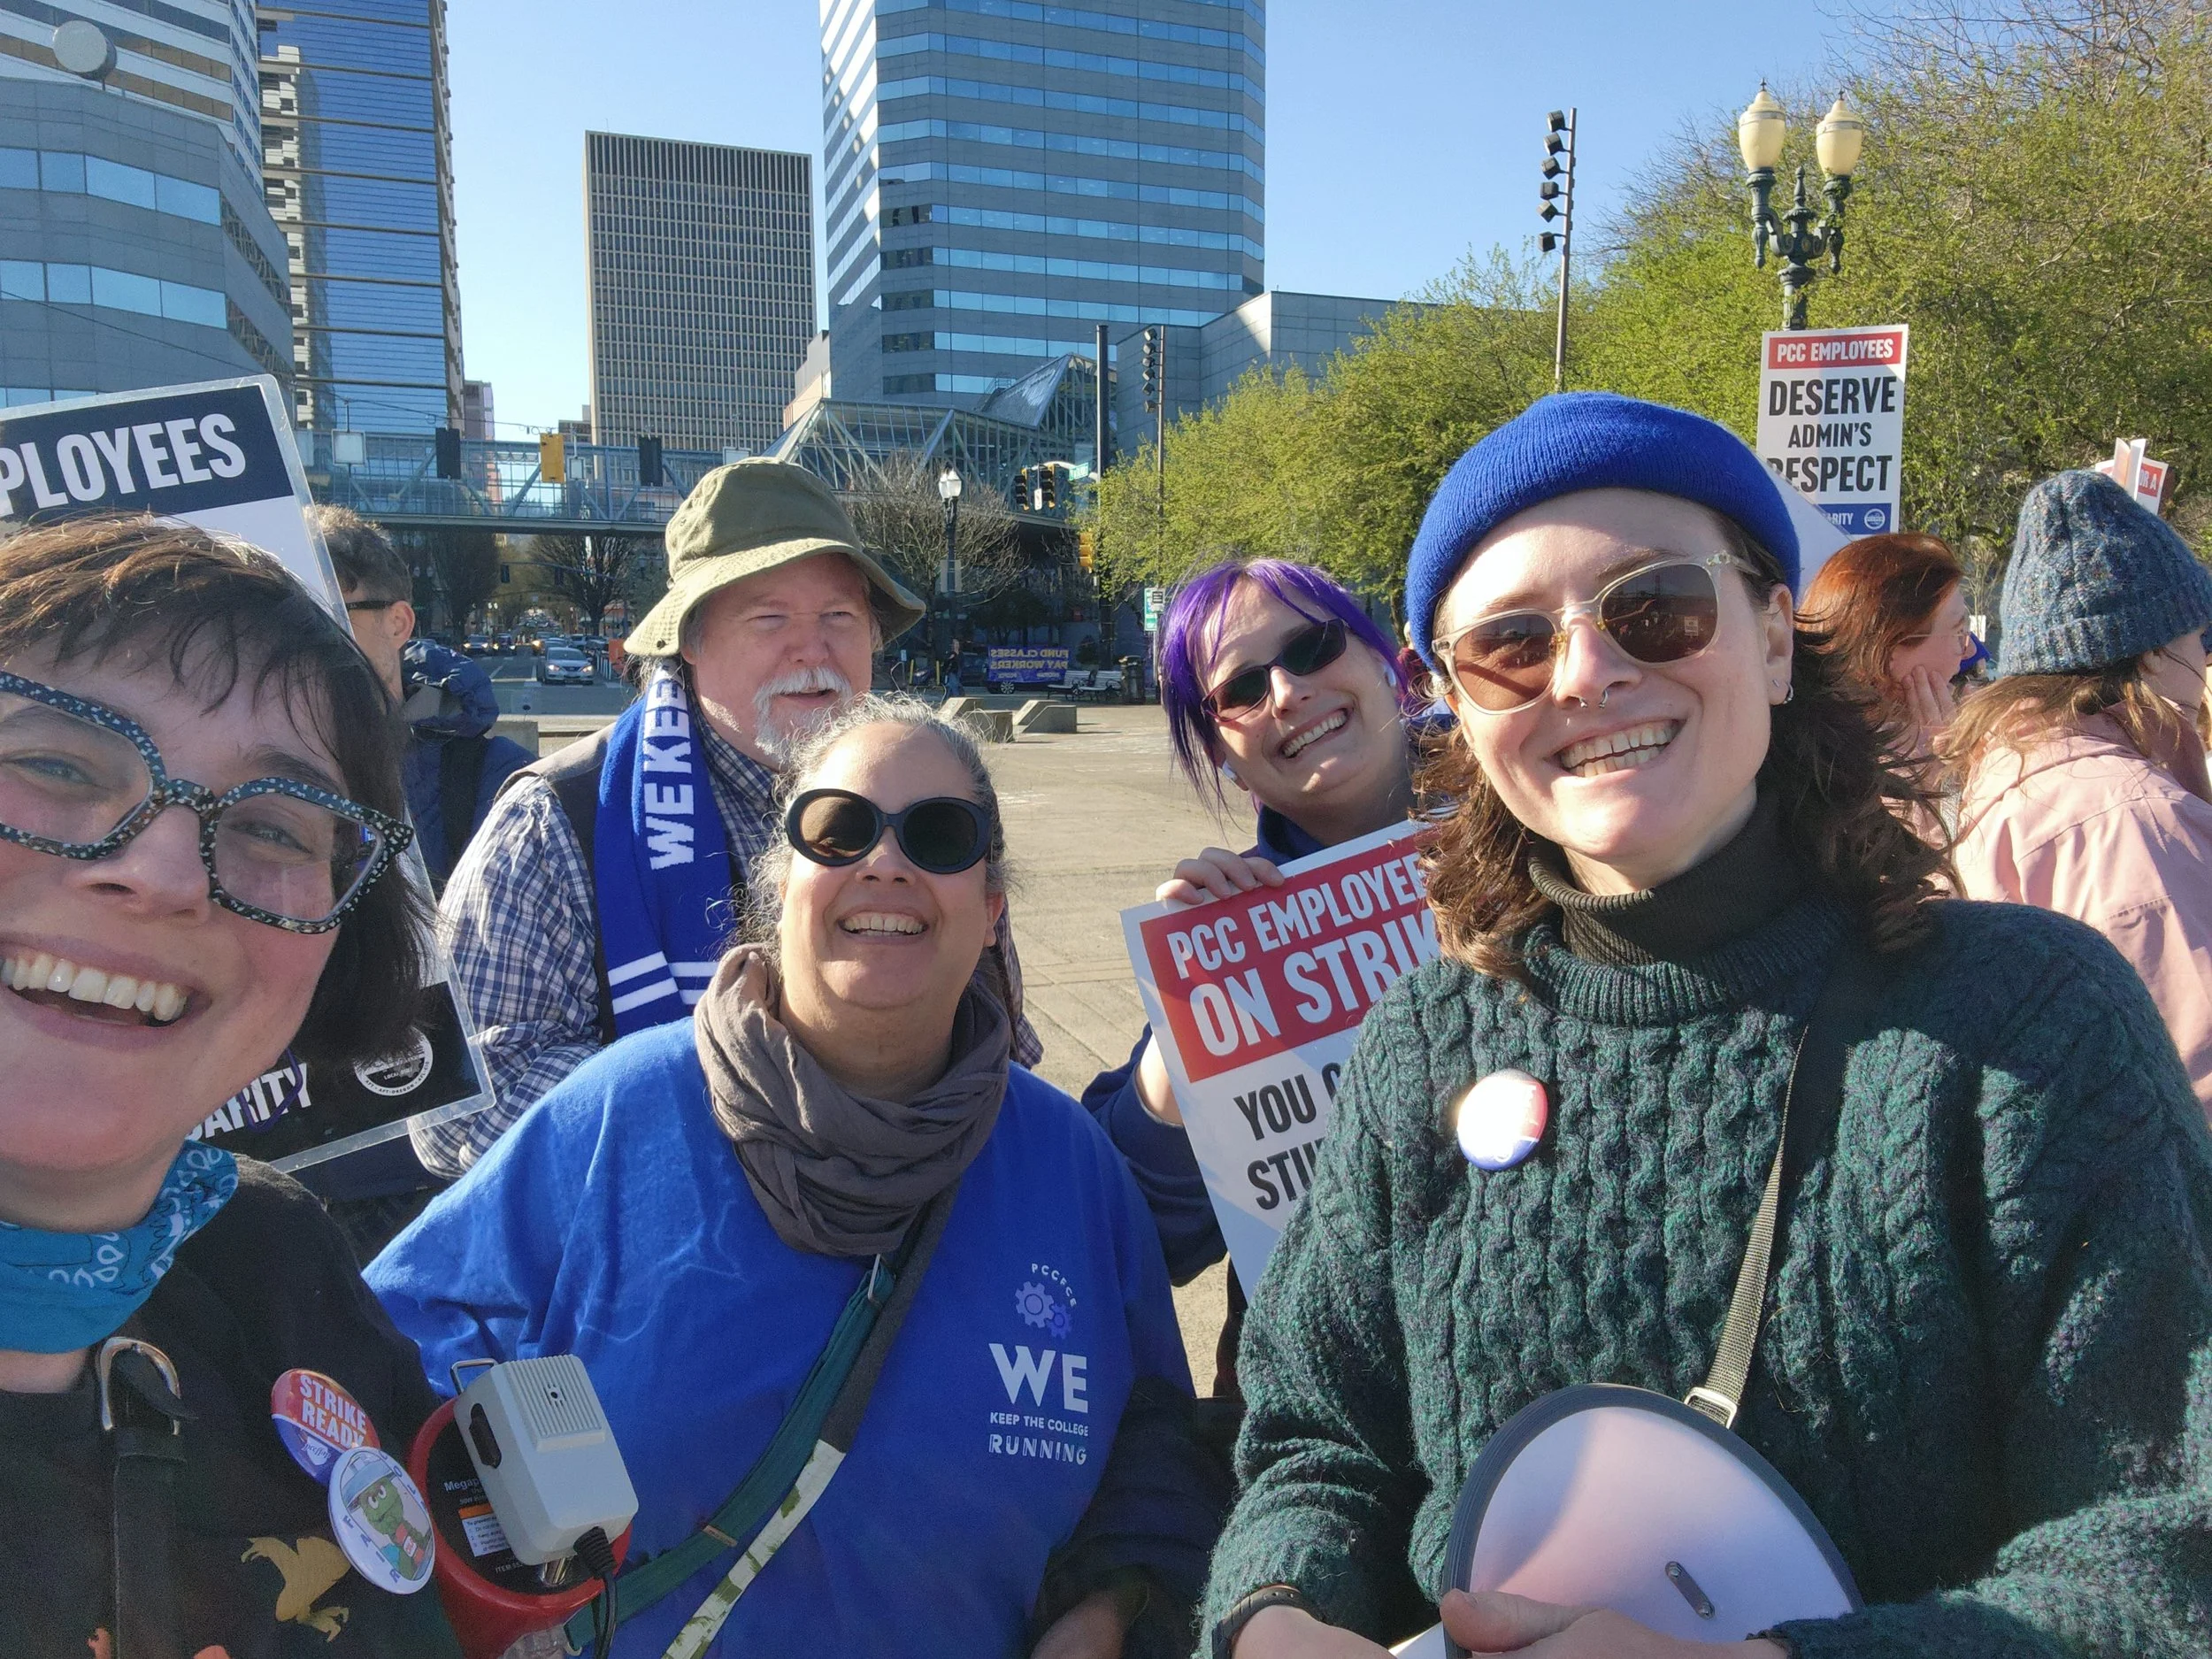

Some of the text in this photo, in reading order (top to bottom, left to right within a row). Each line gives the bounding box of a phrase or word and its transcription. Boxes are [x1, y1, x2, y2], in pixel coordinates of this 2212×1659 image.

[1777, 338, 1893, 363] PCC EMPLOYEES
[1769, 376, 1897, 416] DESERVE
[1788, 422, 1872, 448] ADMIN'S
[644, 782, 695, 870] WE
[1167, 916, 1246, 980] PCC
[1189, 968, 1280, 1057] ON
[1233, 1072, 1317, 1141] YOU
[300, 1374, 367, 1433] STRIKE
[988, 1343, 1089, 1414] WE
[302, 1399, 365, 1449] READY
[988, 1433, 1087, 1465] RUNNING
[990, 1412, 1089, 1437] KEEP THE COLLEGE
